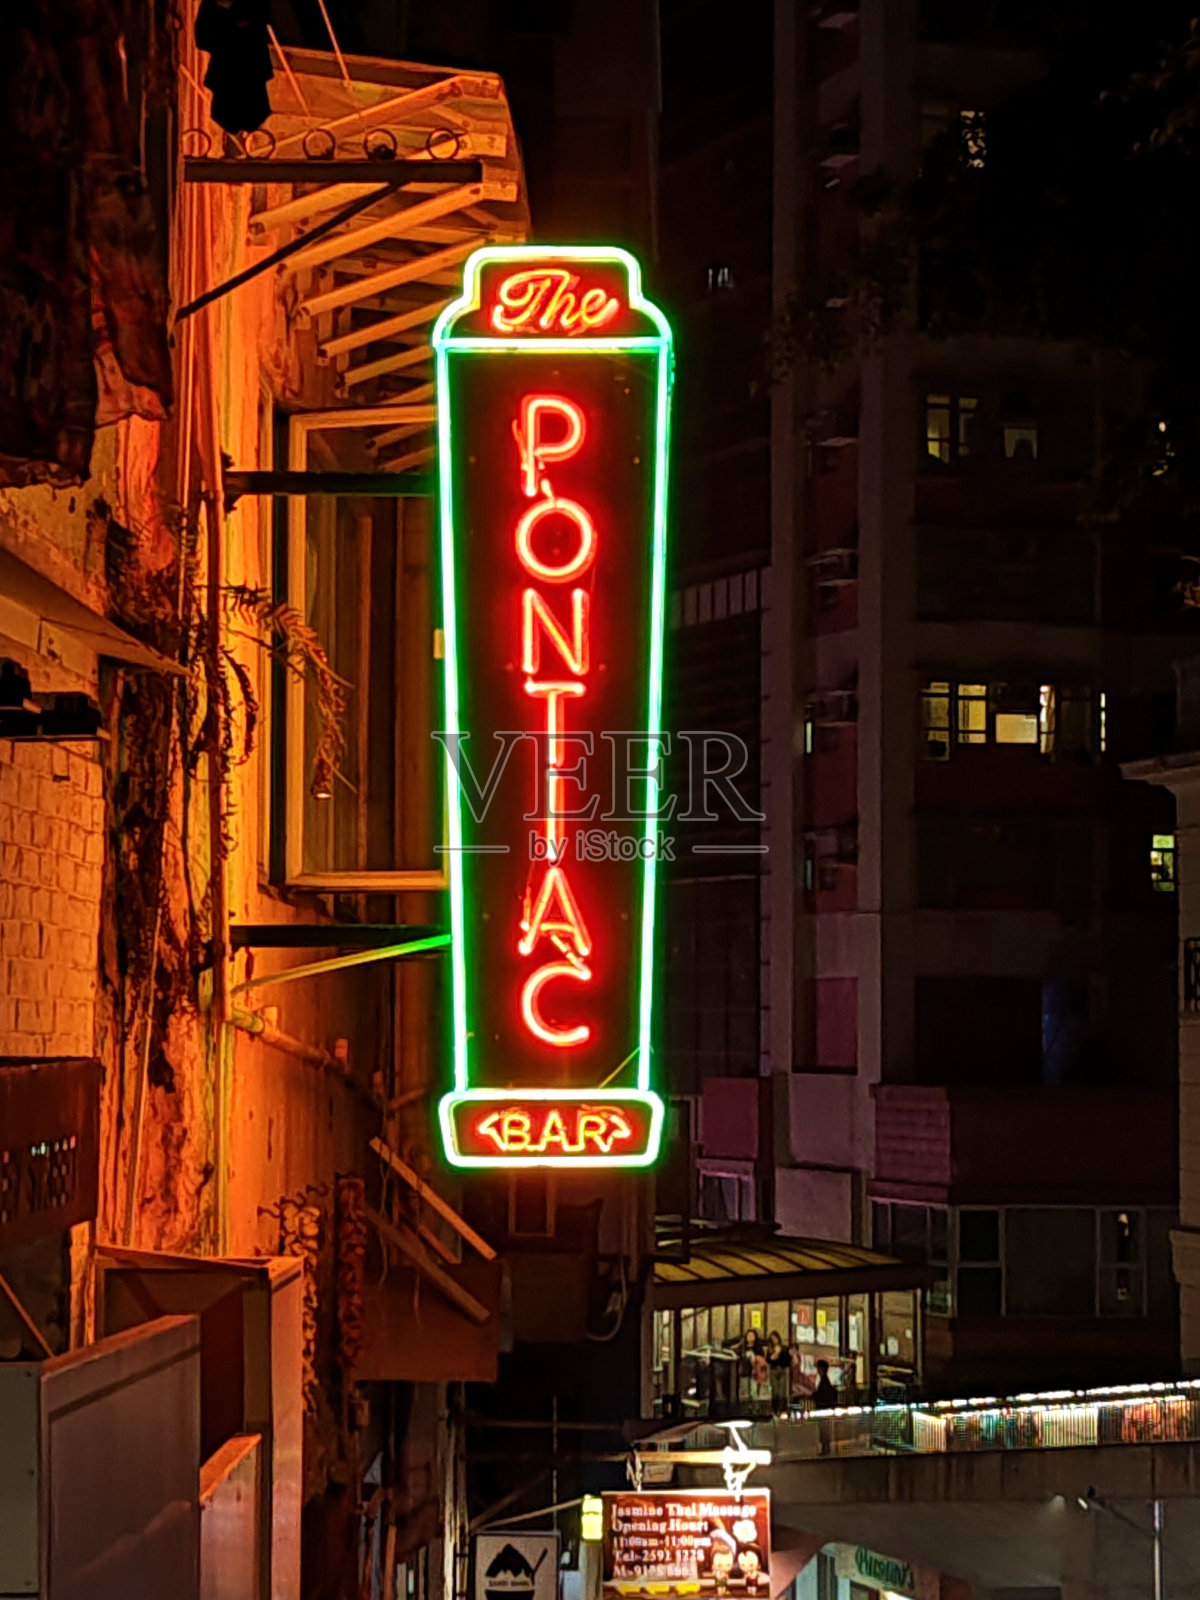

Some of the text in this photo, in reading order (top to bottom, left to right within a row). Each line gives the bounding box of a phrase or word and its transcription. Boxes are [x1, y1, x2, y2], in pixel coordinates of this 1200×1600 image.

[493, 268, 619, 333] The
[514, 393, 598, 1047] PONTIAC
[499, 1111, 612, 1152] BAR
[612, 1519, 667, 1534] Opening
